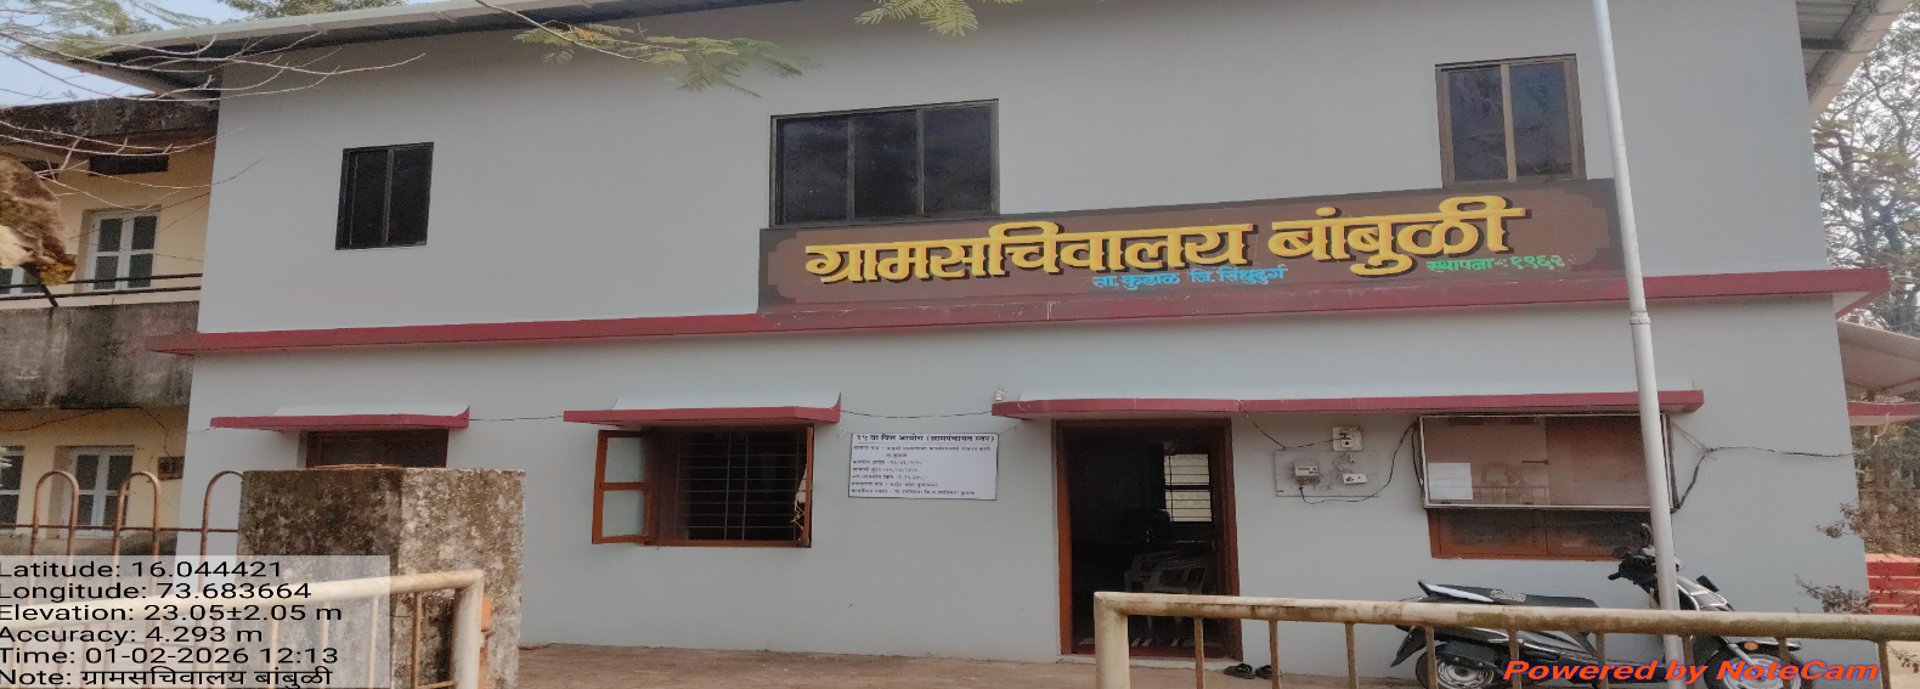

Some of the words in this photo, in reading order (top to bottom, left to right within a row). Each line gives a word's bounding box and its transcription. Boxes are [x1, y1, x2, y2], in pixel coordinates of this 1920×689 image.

[805, 220, 1257, 284] ग्रामसचिवालय
[1267, 195, 1531, 277] बांबुळी
[1121, 272, 1181, 290] कुडाळ
